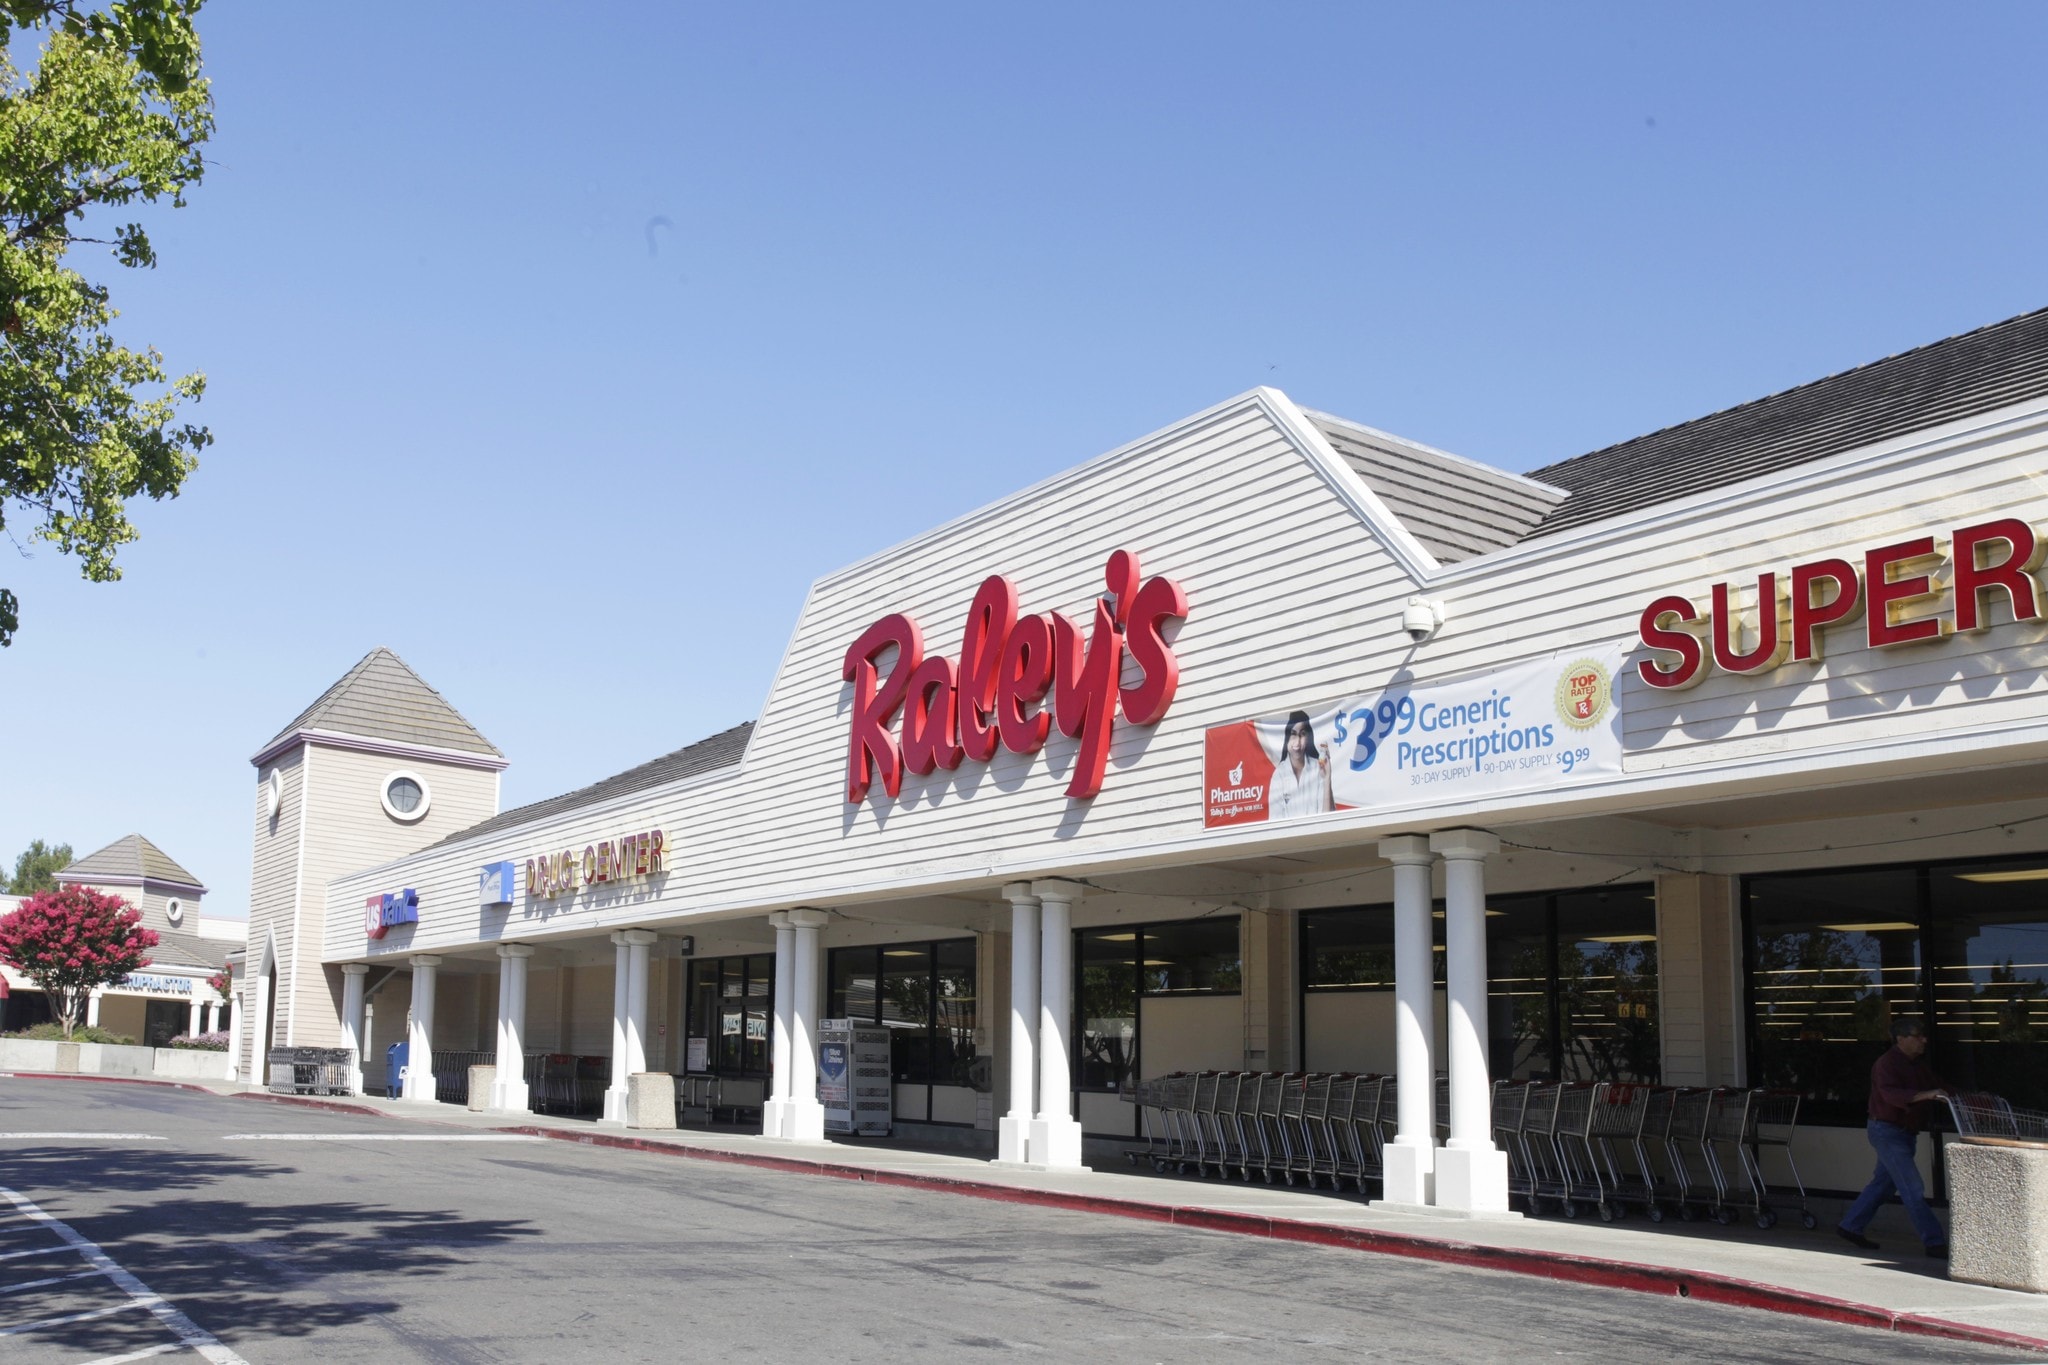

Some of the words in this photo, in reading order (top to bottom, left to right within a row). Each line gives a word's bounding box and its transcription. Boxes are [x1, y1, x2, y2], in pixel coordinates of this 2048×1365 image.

[1637, 518, 2042, 691] SUPER
[843, 549, 1189, 803] Raley's
[1570, 674, 1597, 688] TOP
[1571, 685, 1597, 697] RATED
[1419, 689, 1511, 732] Generic
[1398, 722, 1554, 771] Prescriptions
[1410, 771, 1440, 785] 30-DAY
[1442, 766, 1472, 781] SUPPLY
[1484, 759, 1518, 774] 90-DAY
[1519, 753, 1553, 769] SUPPLY
[1211, 785, 1263, 803] Pharmacy
[525, 850, 576, 898] DRUG
[583, 829, 667, 885] CENTER
